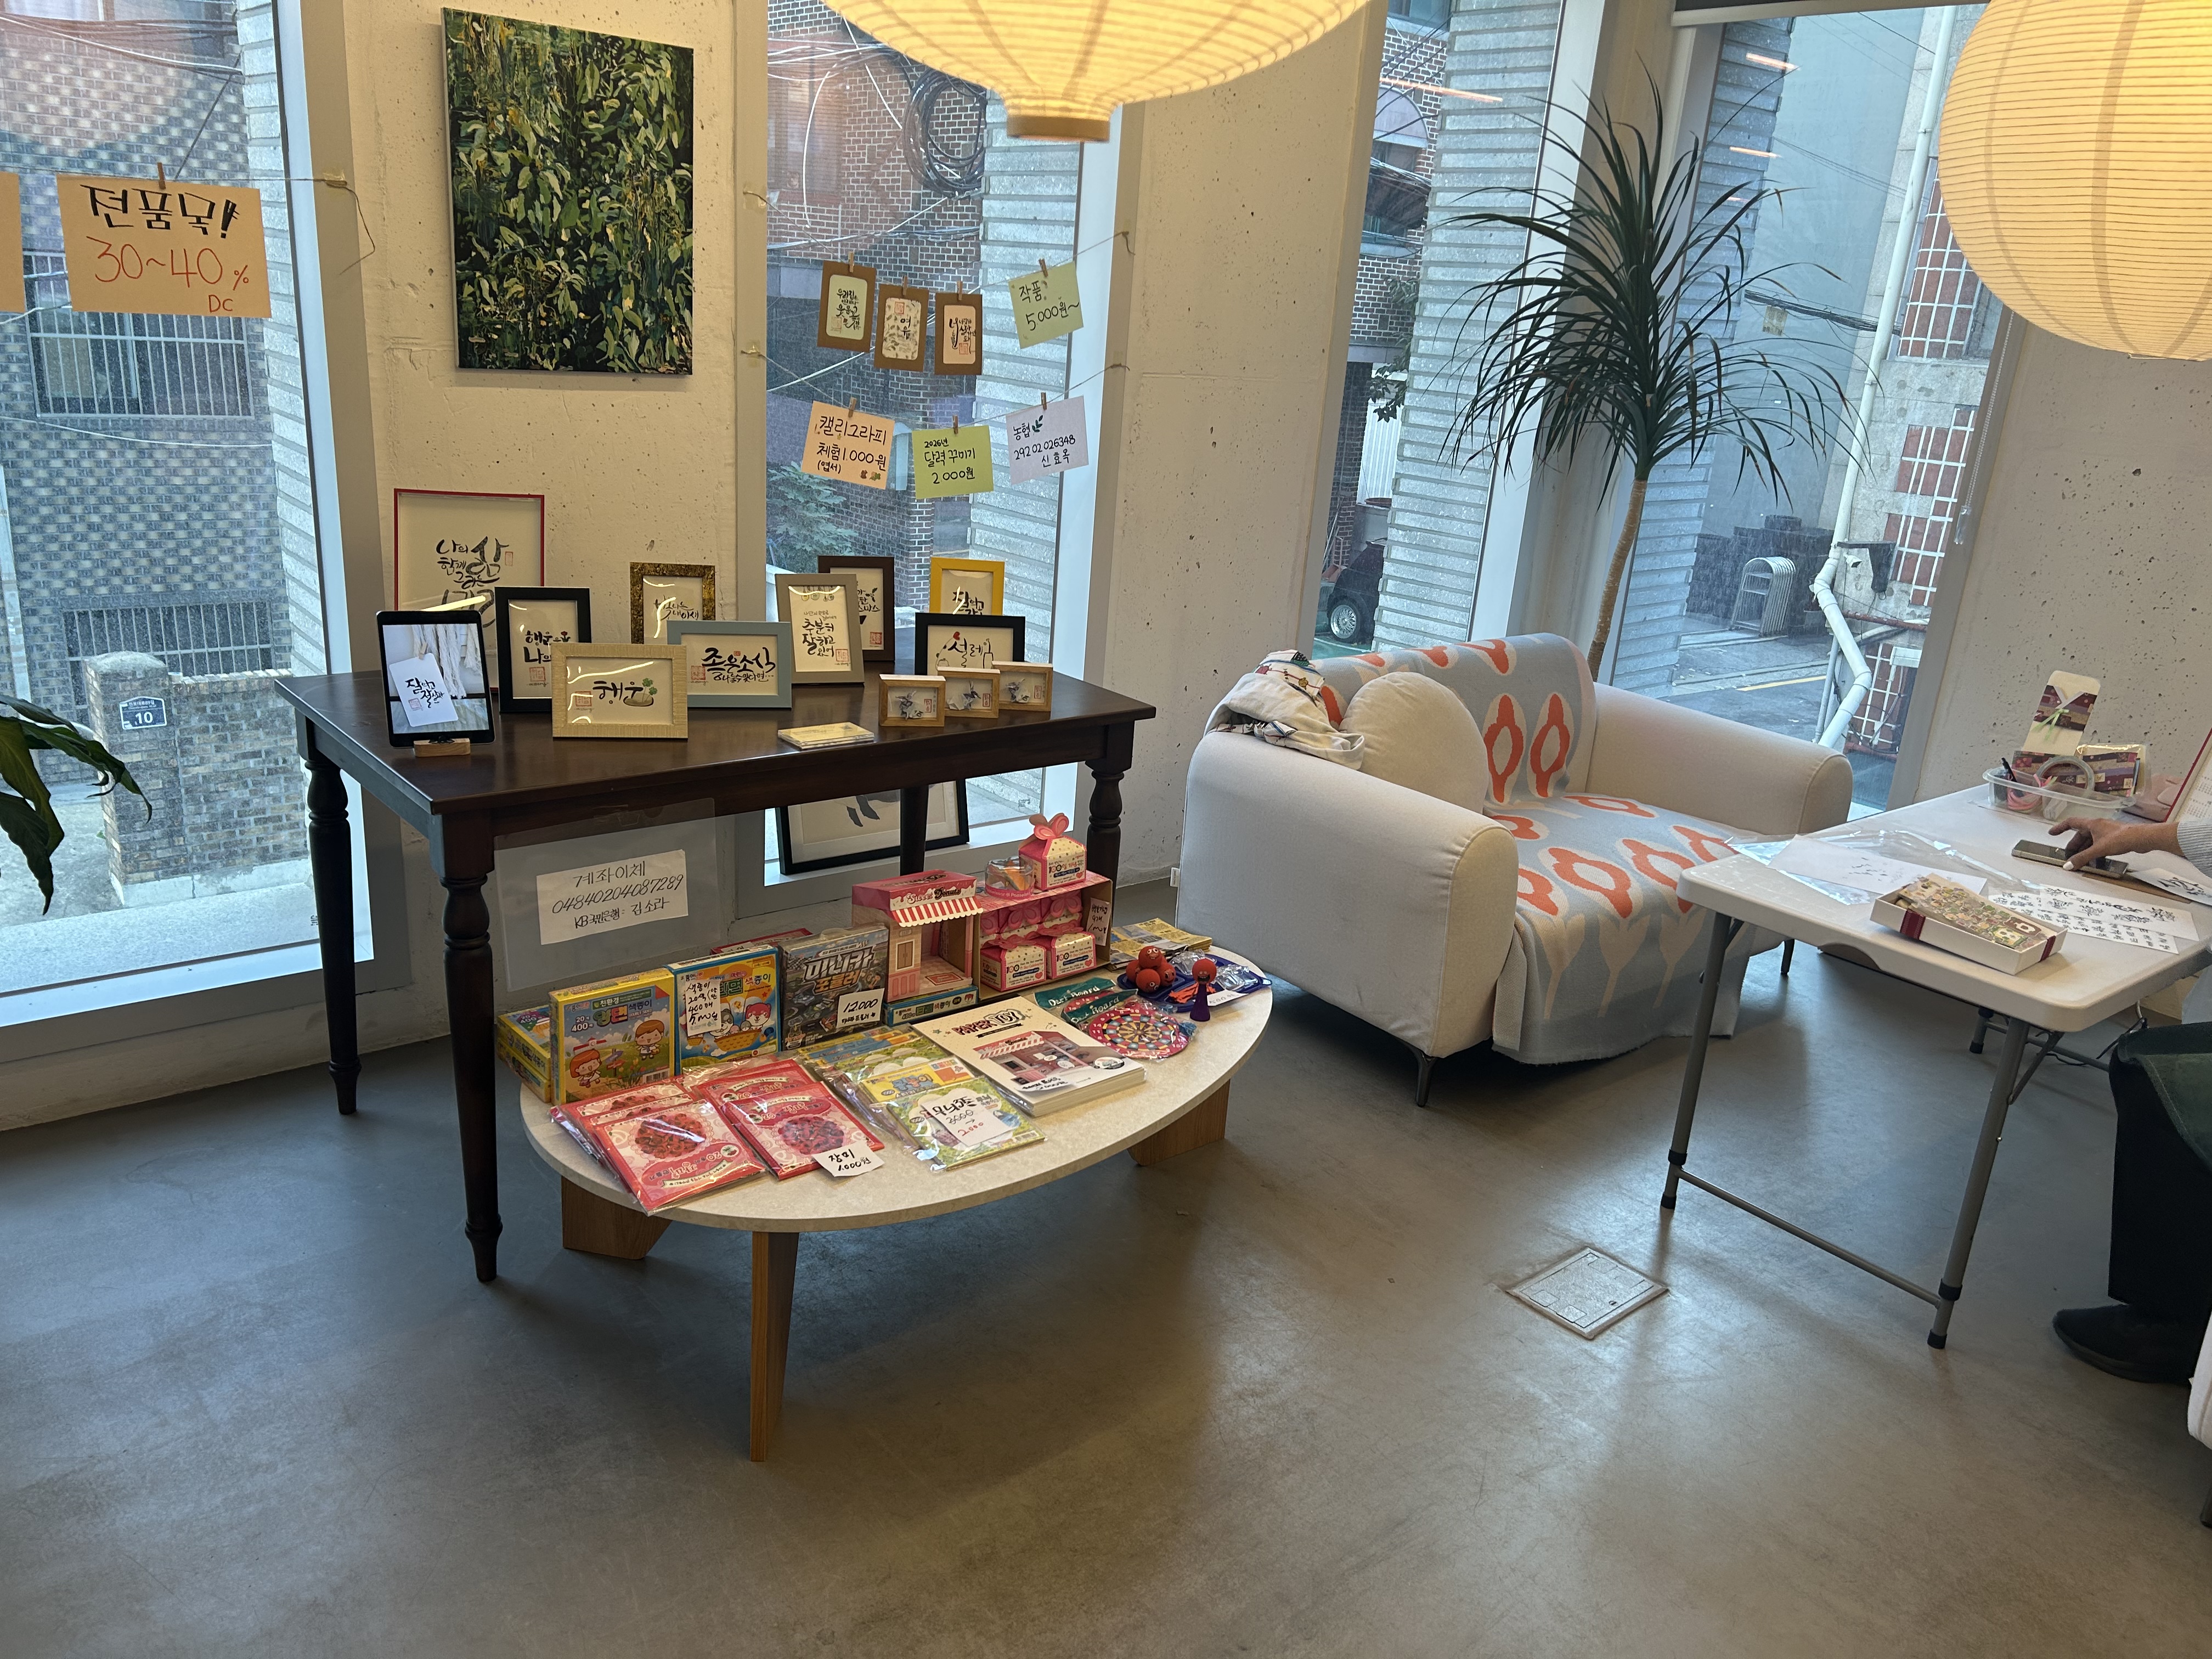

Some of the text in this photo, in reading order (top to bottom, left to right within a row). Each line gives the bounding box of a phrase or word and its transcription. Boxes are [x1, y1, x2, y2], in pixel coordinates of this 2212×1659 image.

[80, 184, 240, 239] 전품목!
[208, 295, 234, 312] DC
[820, 416, 887, 445] 캘리그라피
[1013, 422, 1030, 441] 농협
[816, 442, 840, 461] 체험
[924, 437, 949, 448] 2026년
[1014, 435, 1076, 460] 292 02 026348
[924, 448, 975, 467] 달력 꾸미기
[817, 460, 842, 474] (엽서)
[436, 539, 468, 554] 나의
[135, 712, 154, 724] 10
[573, 861, 646, 887] 계좌이체
[906, 887, 962, 905] Sweet Donuts
[803, 945, 876, 981] 미니카
[745, 973, 771, 986] 색종이
[600, 997, 619, 1007] 친환경
[1048, 985, 1100, 1006] Dart Board
[629, 1000, 652, 1011] 색종이
[1091, 996, 1120, 1015] Board
[571, 1023, 594, 1032] 400
[576, 1015, 590, 1024] 20
[952, 1018, 996, 1036] PAPER
[992, 1011, 1022, 1025] TOY
[828, 1148, 855, 1163] 장미
